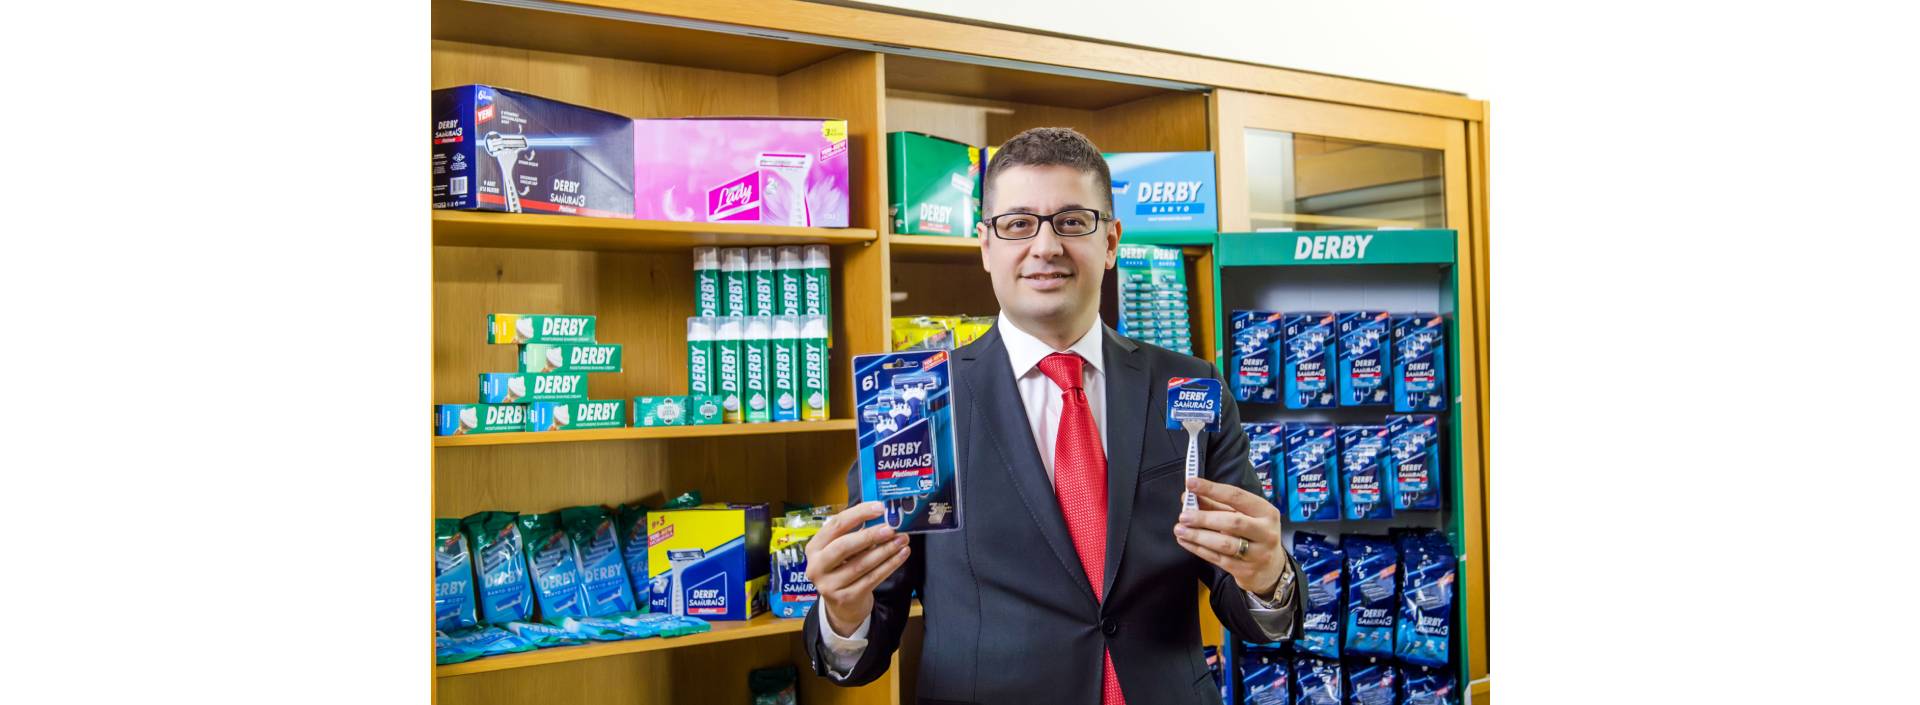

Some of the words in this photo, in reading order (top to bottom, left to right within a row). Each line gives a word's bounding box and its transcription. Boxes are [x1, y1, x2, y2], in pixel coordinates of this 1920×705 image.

[438, 119, 459, 130] DERBY
[553, 178, 580, 193] DERBY
[1137, 181, 1203, 203] DERBY
[713, 182, 752, 214] Lady
[920, 202, 953, 224] DERBY
[1120, 247, 1147, 259] DERBY
[1153, 248, 1180, 260] DERBY
[1294, 235, 1373, 260] DERBY
[700, 273, 716, 318] DERBY
[728, 275, 743, 319] DERBY
[756, 274, 771, 319] DERBY
[783, 273, 799, 318] DERBY
[806, 273, 820, 318] DERBY
[541, 317, 588, 336] DERBY
[570, 346, 616, 365] DERBY
[1243, 358, 1264, 366] DERBY
[1355, 359, 1377, 367] DERBY
[691, 345, 706, 392] DERBY
[721, 345, 736, 391] DERBY
[748, 344, 762, 390] DERBY
[776, 343, 790, 389] DERBY
[806, 343, 821, 389] DERBY
[1299, 362, 1320, 370] DERBY
[1408, 362, 1430, 370] DERBY
[534, 375, 580, 393] DERBY
[862, 375, 873, 391] 6
[1179, 391, 1208, 401] DERBY
[577, 403, 619, 421] DERBY
[882, 441, 922, 457] DERBY
[1301, 473, 1322, 482] DERBY
[1352, 475, 1374, 483] DERBY
[484, 567, 523, 588] DERBY
[541, 569, 576, 590] DERBY
[584, 562, 622, 584] DERBY
[790, 571, 810, 582] DER
[435, 580, 467, 596] ERBY
[693, 589, 719, 599] DERBY
[1363, 608, 1388, 618] DERBY
